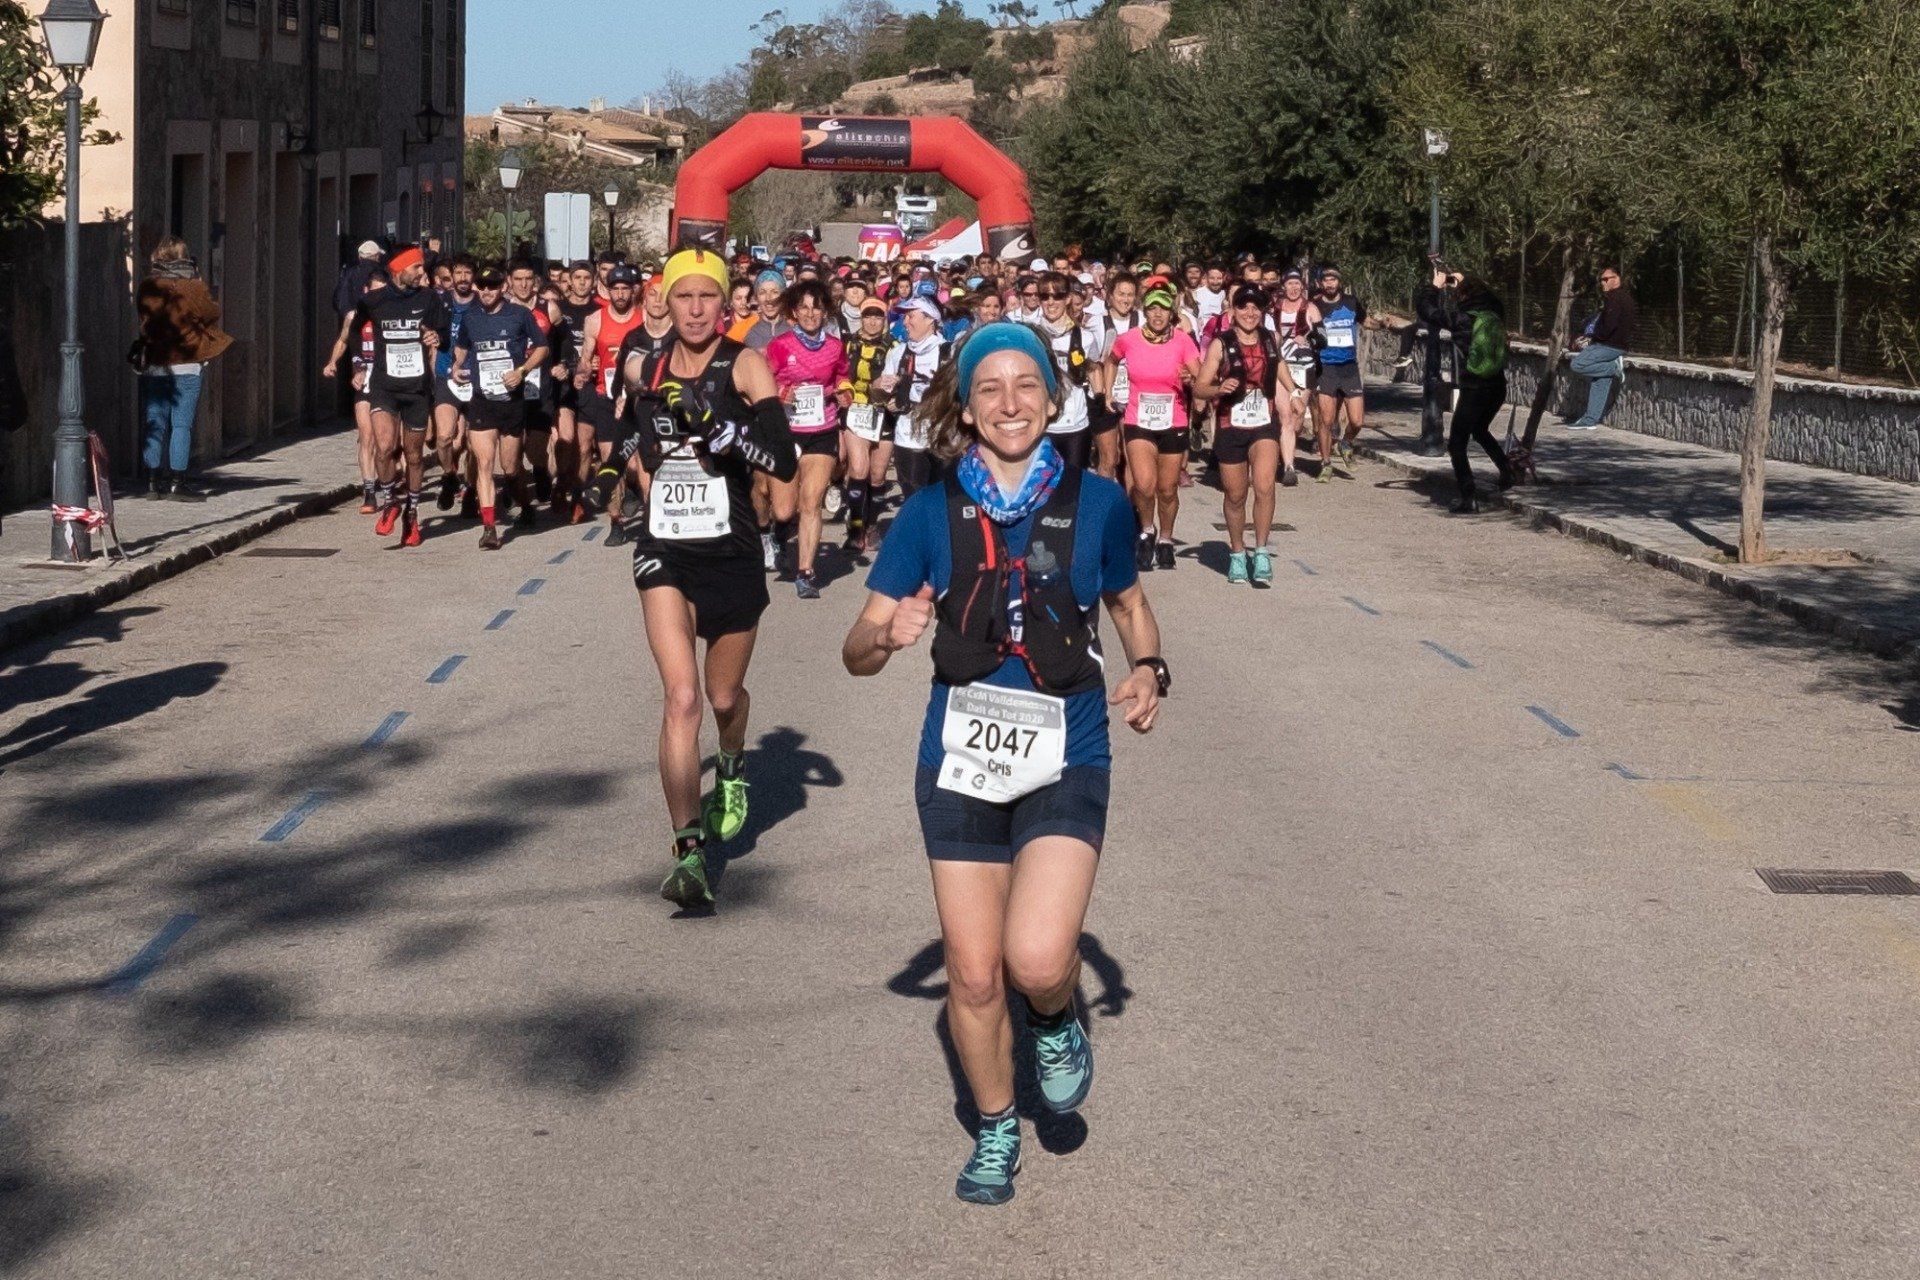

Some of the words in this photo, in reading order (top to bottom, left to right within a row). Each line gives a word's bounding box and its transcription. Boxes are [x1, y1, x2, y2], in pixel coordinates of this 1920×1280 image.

[835, 132, 907, 144] elitechip
[662, 483, 708, 504] 2077
[987, 707, 1000, 717] de
[1018, 712, 1044, 724] 2020
[965, 718, 1039, 759] 2047
